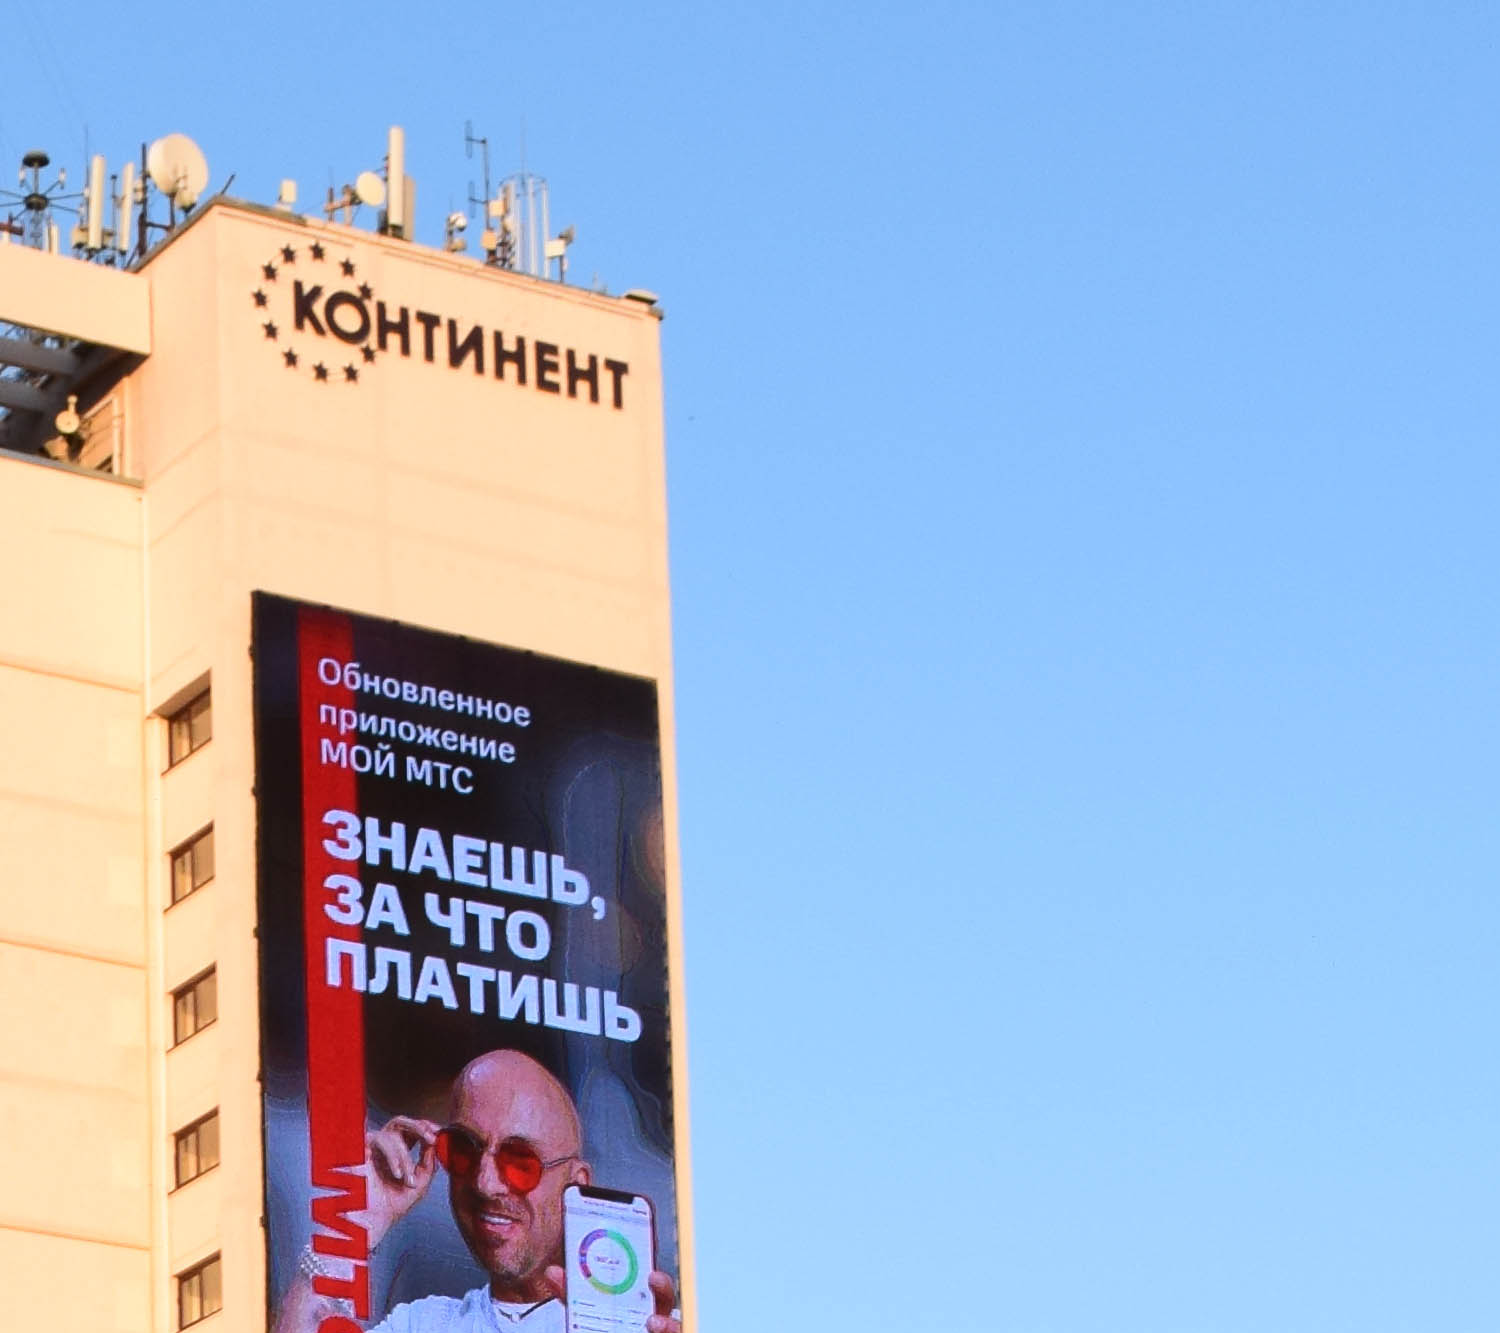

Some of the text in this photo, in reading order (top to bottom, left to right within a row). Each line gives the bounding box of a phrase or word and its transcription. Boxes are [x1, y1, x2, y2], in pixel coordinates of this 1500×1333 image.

[292, 280, 630, 410] КОНТИНЕНТ
[317, 657, 531, 728] Обновленное
[319, 703, 517, 764] приложение
[321, 737, 474, 795] МОЙ МТС
[321, 809, 606, 920] ЗНАЕШЬ,
[323, 874, 552, 962] ЗА ЧТО
[325, 936, 643, 1043] ПЛАТИШЬ
